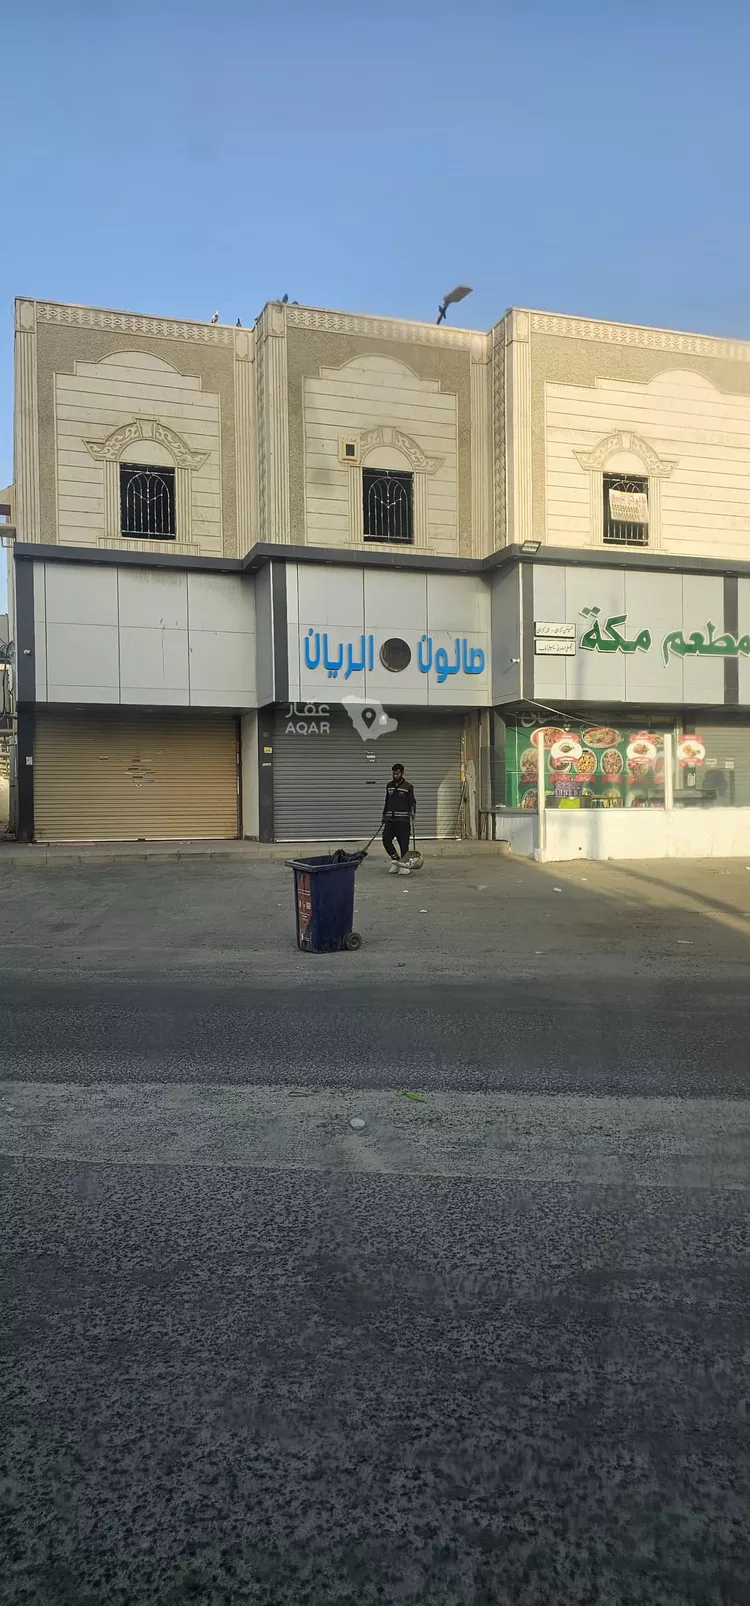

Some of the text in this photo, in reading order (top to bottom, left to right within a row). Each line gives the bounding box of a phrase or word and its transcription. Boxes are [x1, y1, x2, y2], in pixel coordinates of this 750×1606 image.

[304, 628, 486, 683] صالون الريان
[579, 606, 750, 667] مطعم مكة
